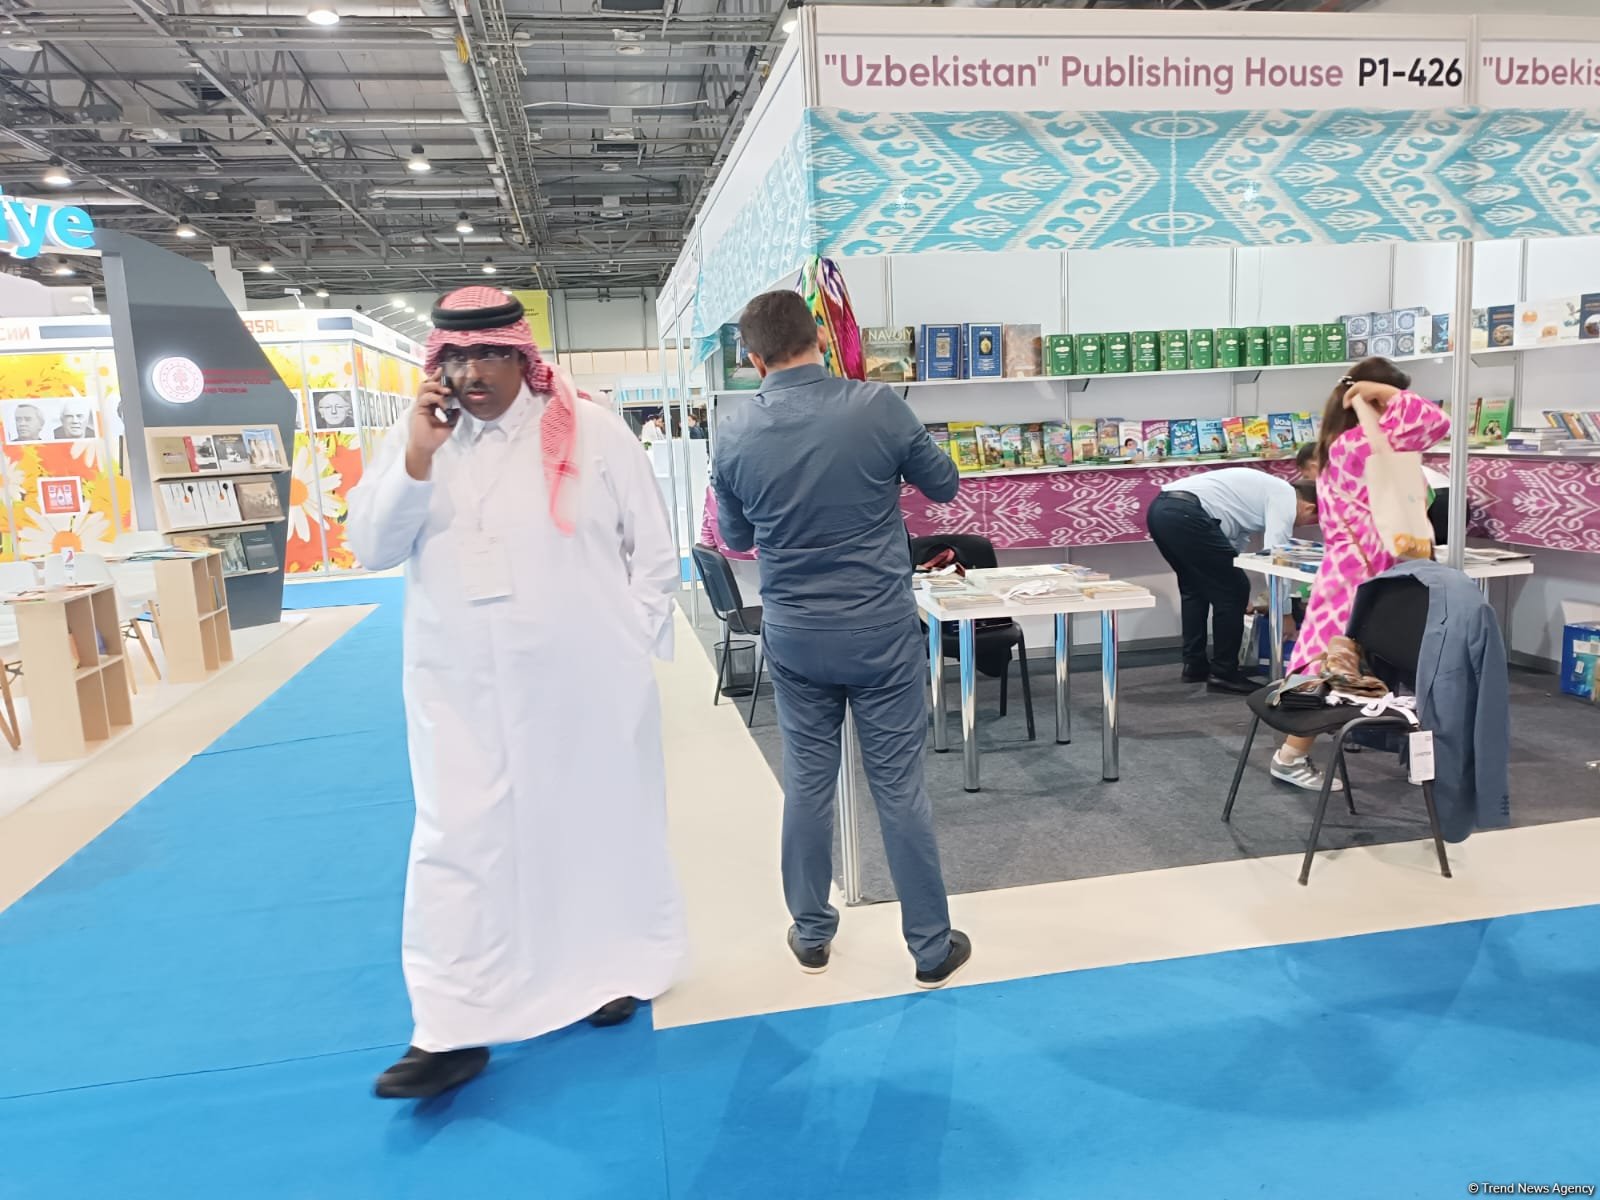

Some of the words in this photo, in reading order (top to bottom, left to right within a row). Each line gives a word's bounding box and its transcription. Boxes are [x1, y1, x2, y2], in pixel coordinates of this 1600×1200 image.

[824, 55, 1050, 87] "Uzbekistan"
[1061, 55, 1234, 95] Publishing
[1245, 56, 1344, 87] House
[1358, 57, 1463, 88] P1-426
